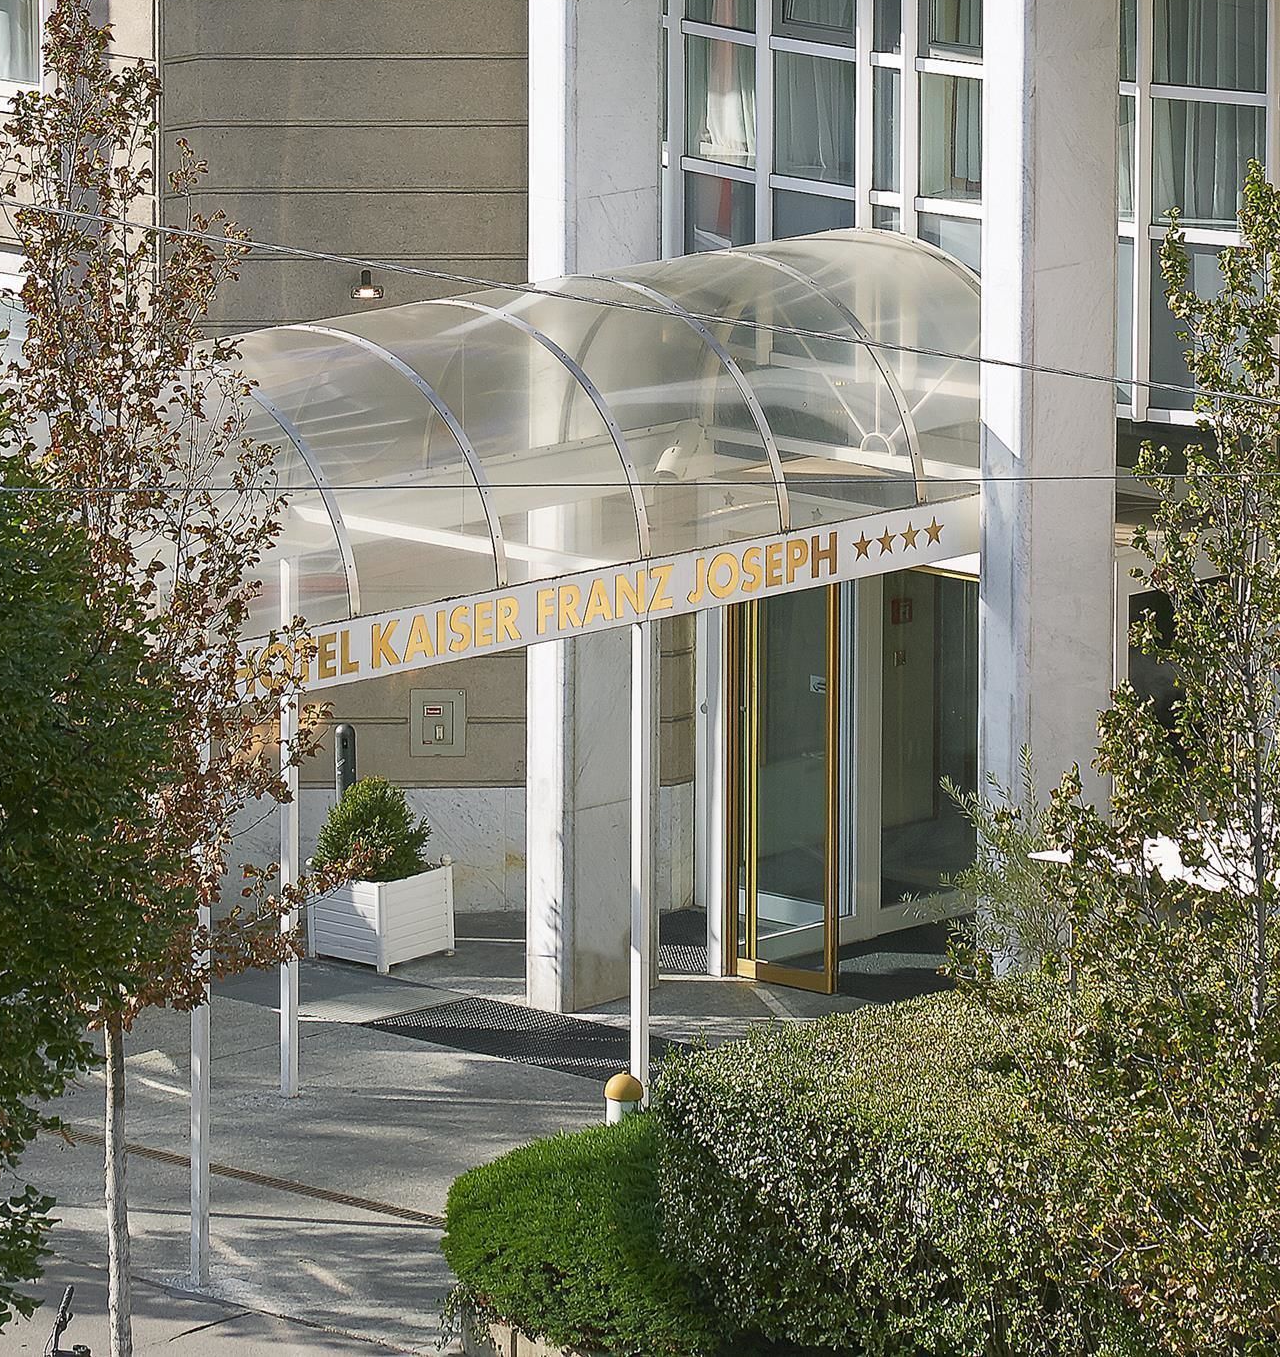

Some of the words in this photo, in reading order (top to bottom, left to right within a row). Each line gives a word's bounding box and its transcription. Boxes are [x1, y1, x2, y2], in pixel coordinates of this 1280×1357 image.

[371, 595, 521, 669] KAISER
[536, 563, 675, 636] FRANZ
[687, 531, 839, 605] JOSEPH
